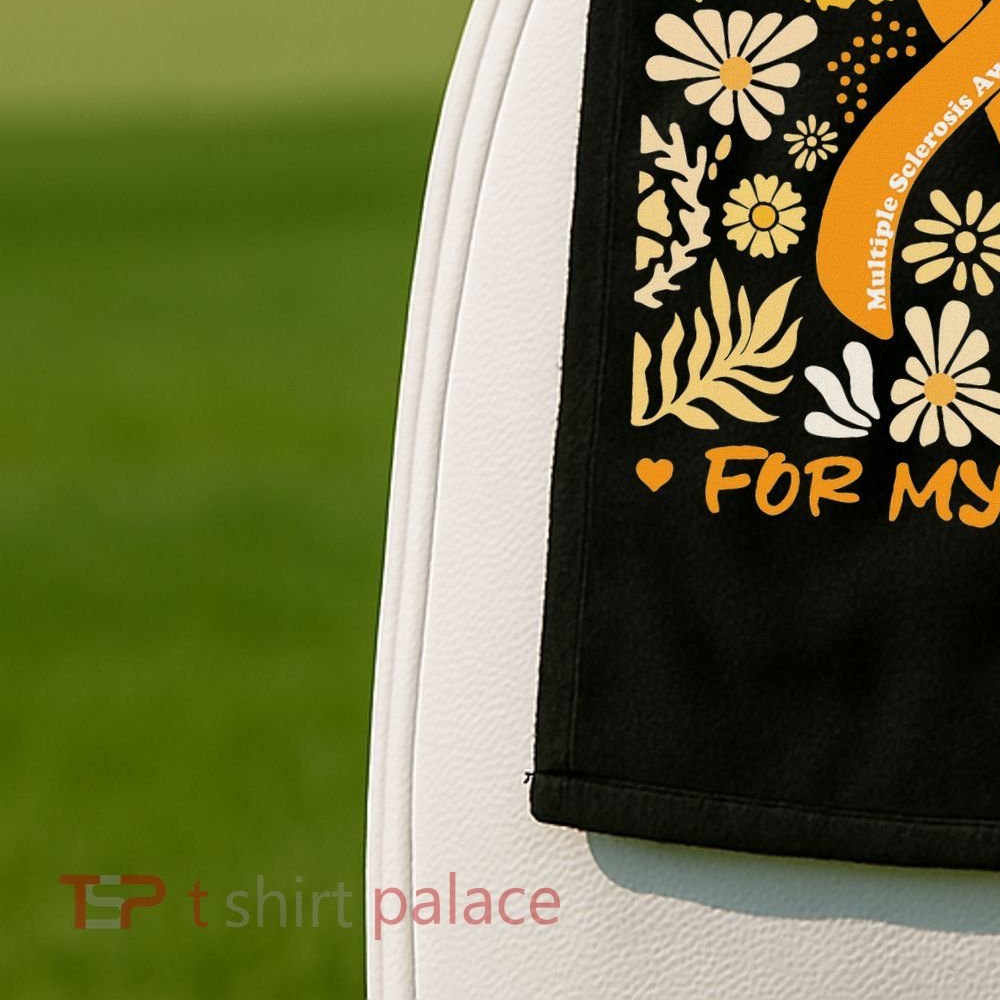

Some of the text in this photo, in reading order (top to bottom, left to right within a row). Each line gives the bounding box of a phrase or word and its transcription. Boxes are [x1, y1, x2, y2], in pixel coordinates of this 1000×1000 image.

[867, 196, 899, 311] Multiple
[889, 94, 973, 193] Sclerosis
[705, 445, 863, 517] FOR
